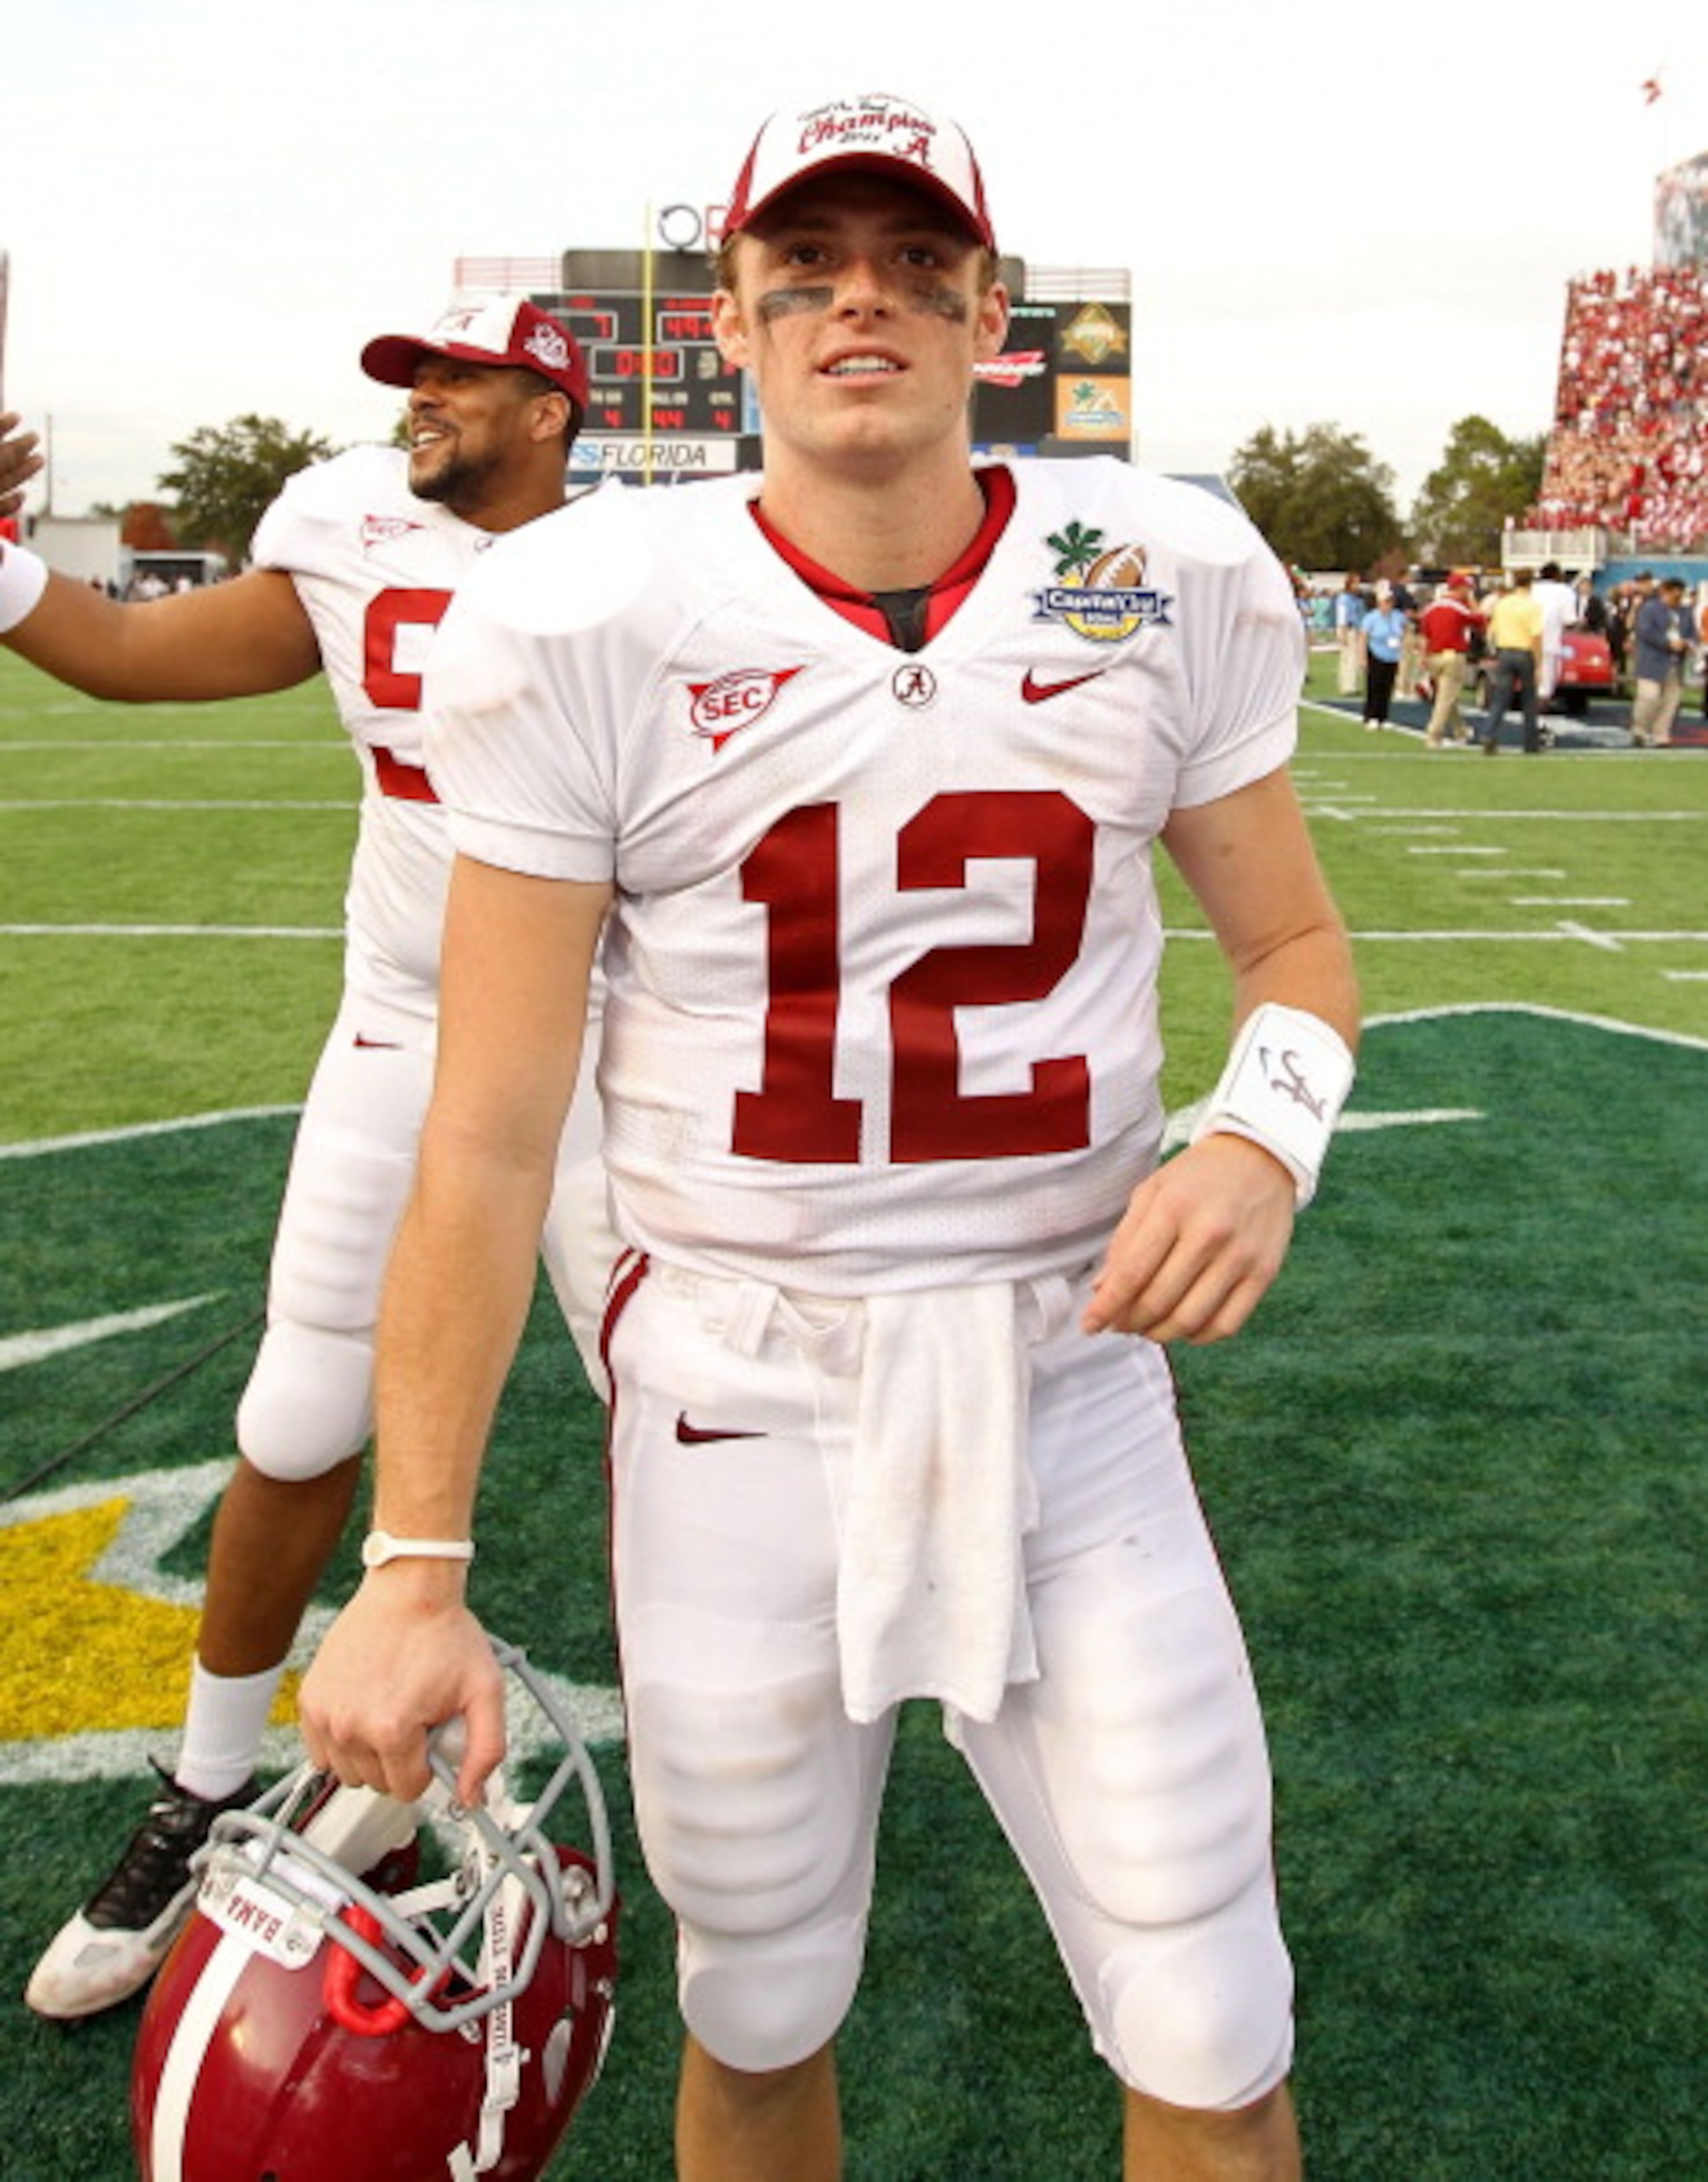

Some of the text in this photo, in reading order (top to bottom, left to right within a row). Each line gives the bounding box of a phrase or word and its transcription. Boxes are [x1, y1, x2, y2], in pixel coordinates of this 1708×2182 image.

[601, 444, 707, 467] FLORIDA
[702, 687, 763, 721] SEC
[731, 790, 1098, 1164] 12
[227, 1895, 284, 1943] BAMA
